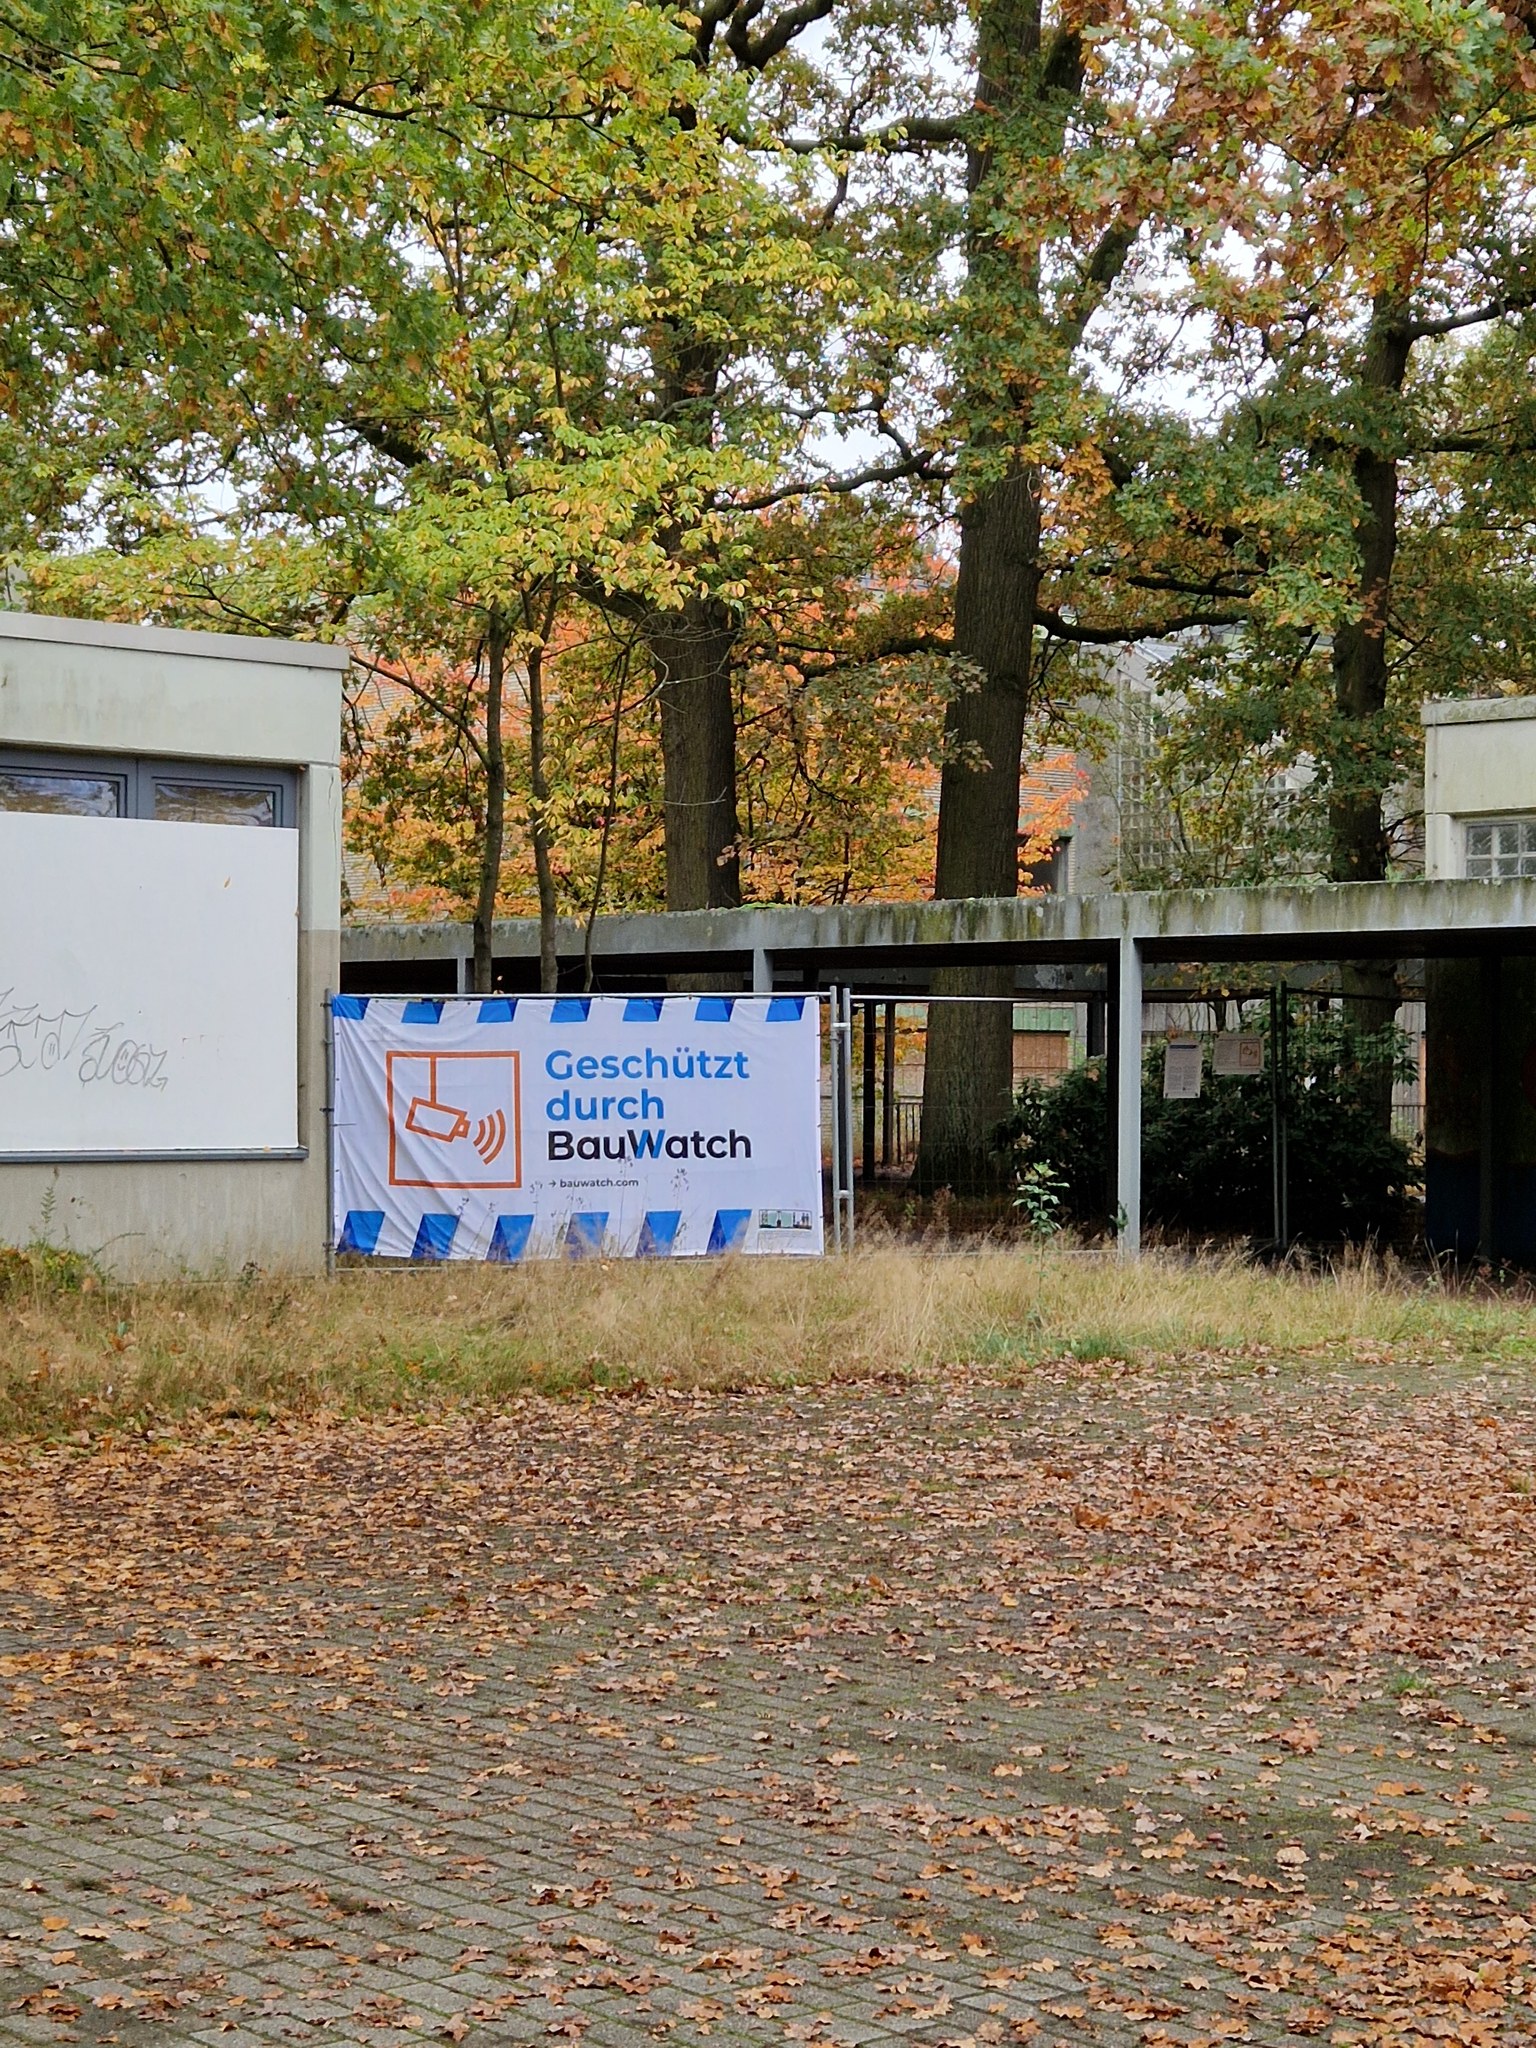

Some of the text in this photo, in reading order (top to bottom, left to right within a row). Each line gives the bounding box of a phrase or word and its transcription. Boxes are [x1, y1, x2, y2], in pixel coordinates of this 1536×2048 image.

[545, 1046, 750, 1081] Geschützt
[545, 1088, 665, 1122] durch
[548, 1128, 752, 1161] BauWatch
[559, 1177, 639, 1189] bauwatch.com
